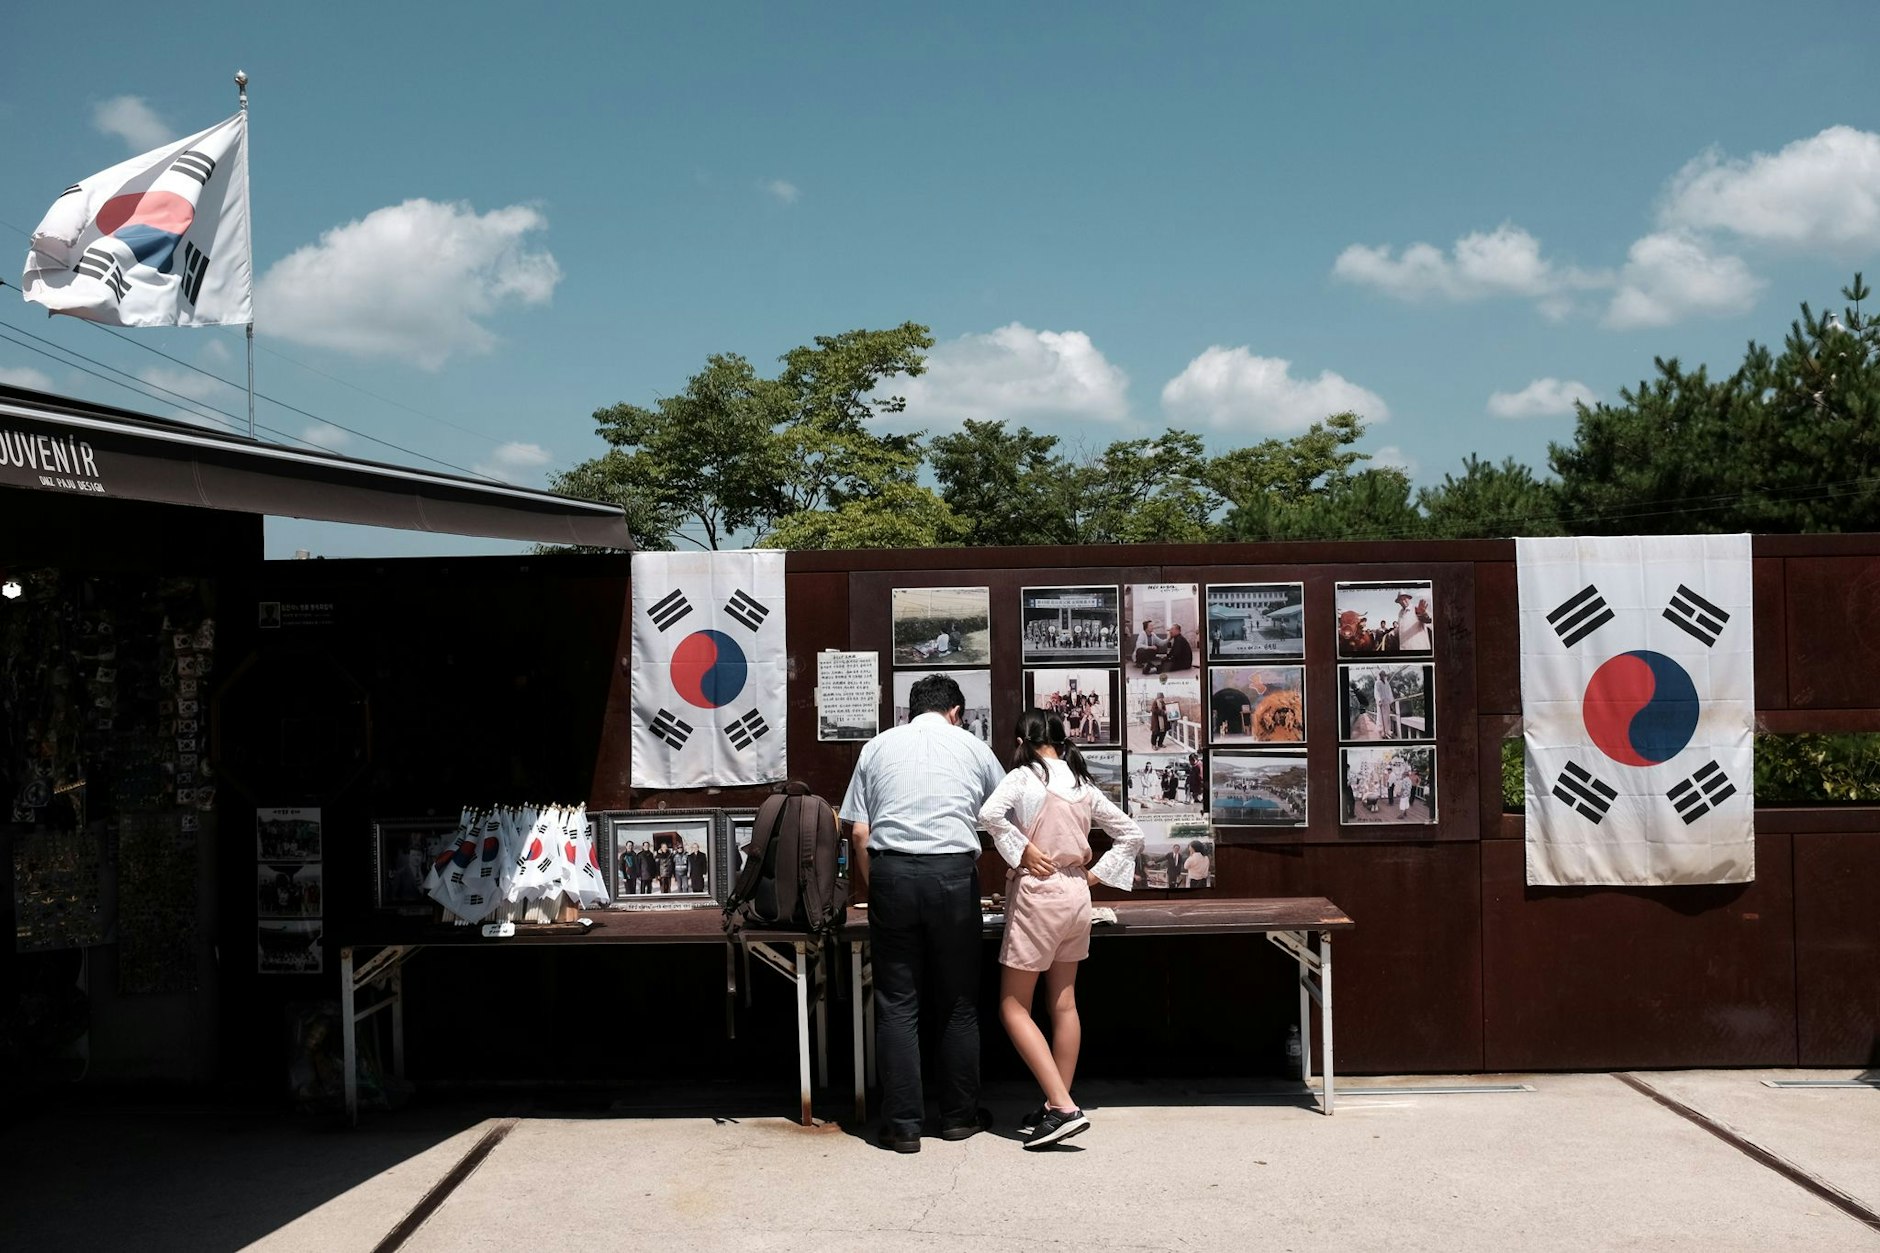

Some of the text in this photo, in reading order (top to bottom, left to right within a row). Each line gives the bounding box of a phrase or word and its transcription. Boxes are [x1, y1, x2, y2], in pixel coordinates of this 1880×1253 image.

[38, 475, 106, 493] DMZ PAJU DESIGN
